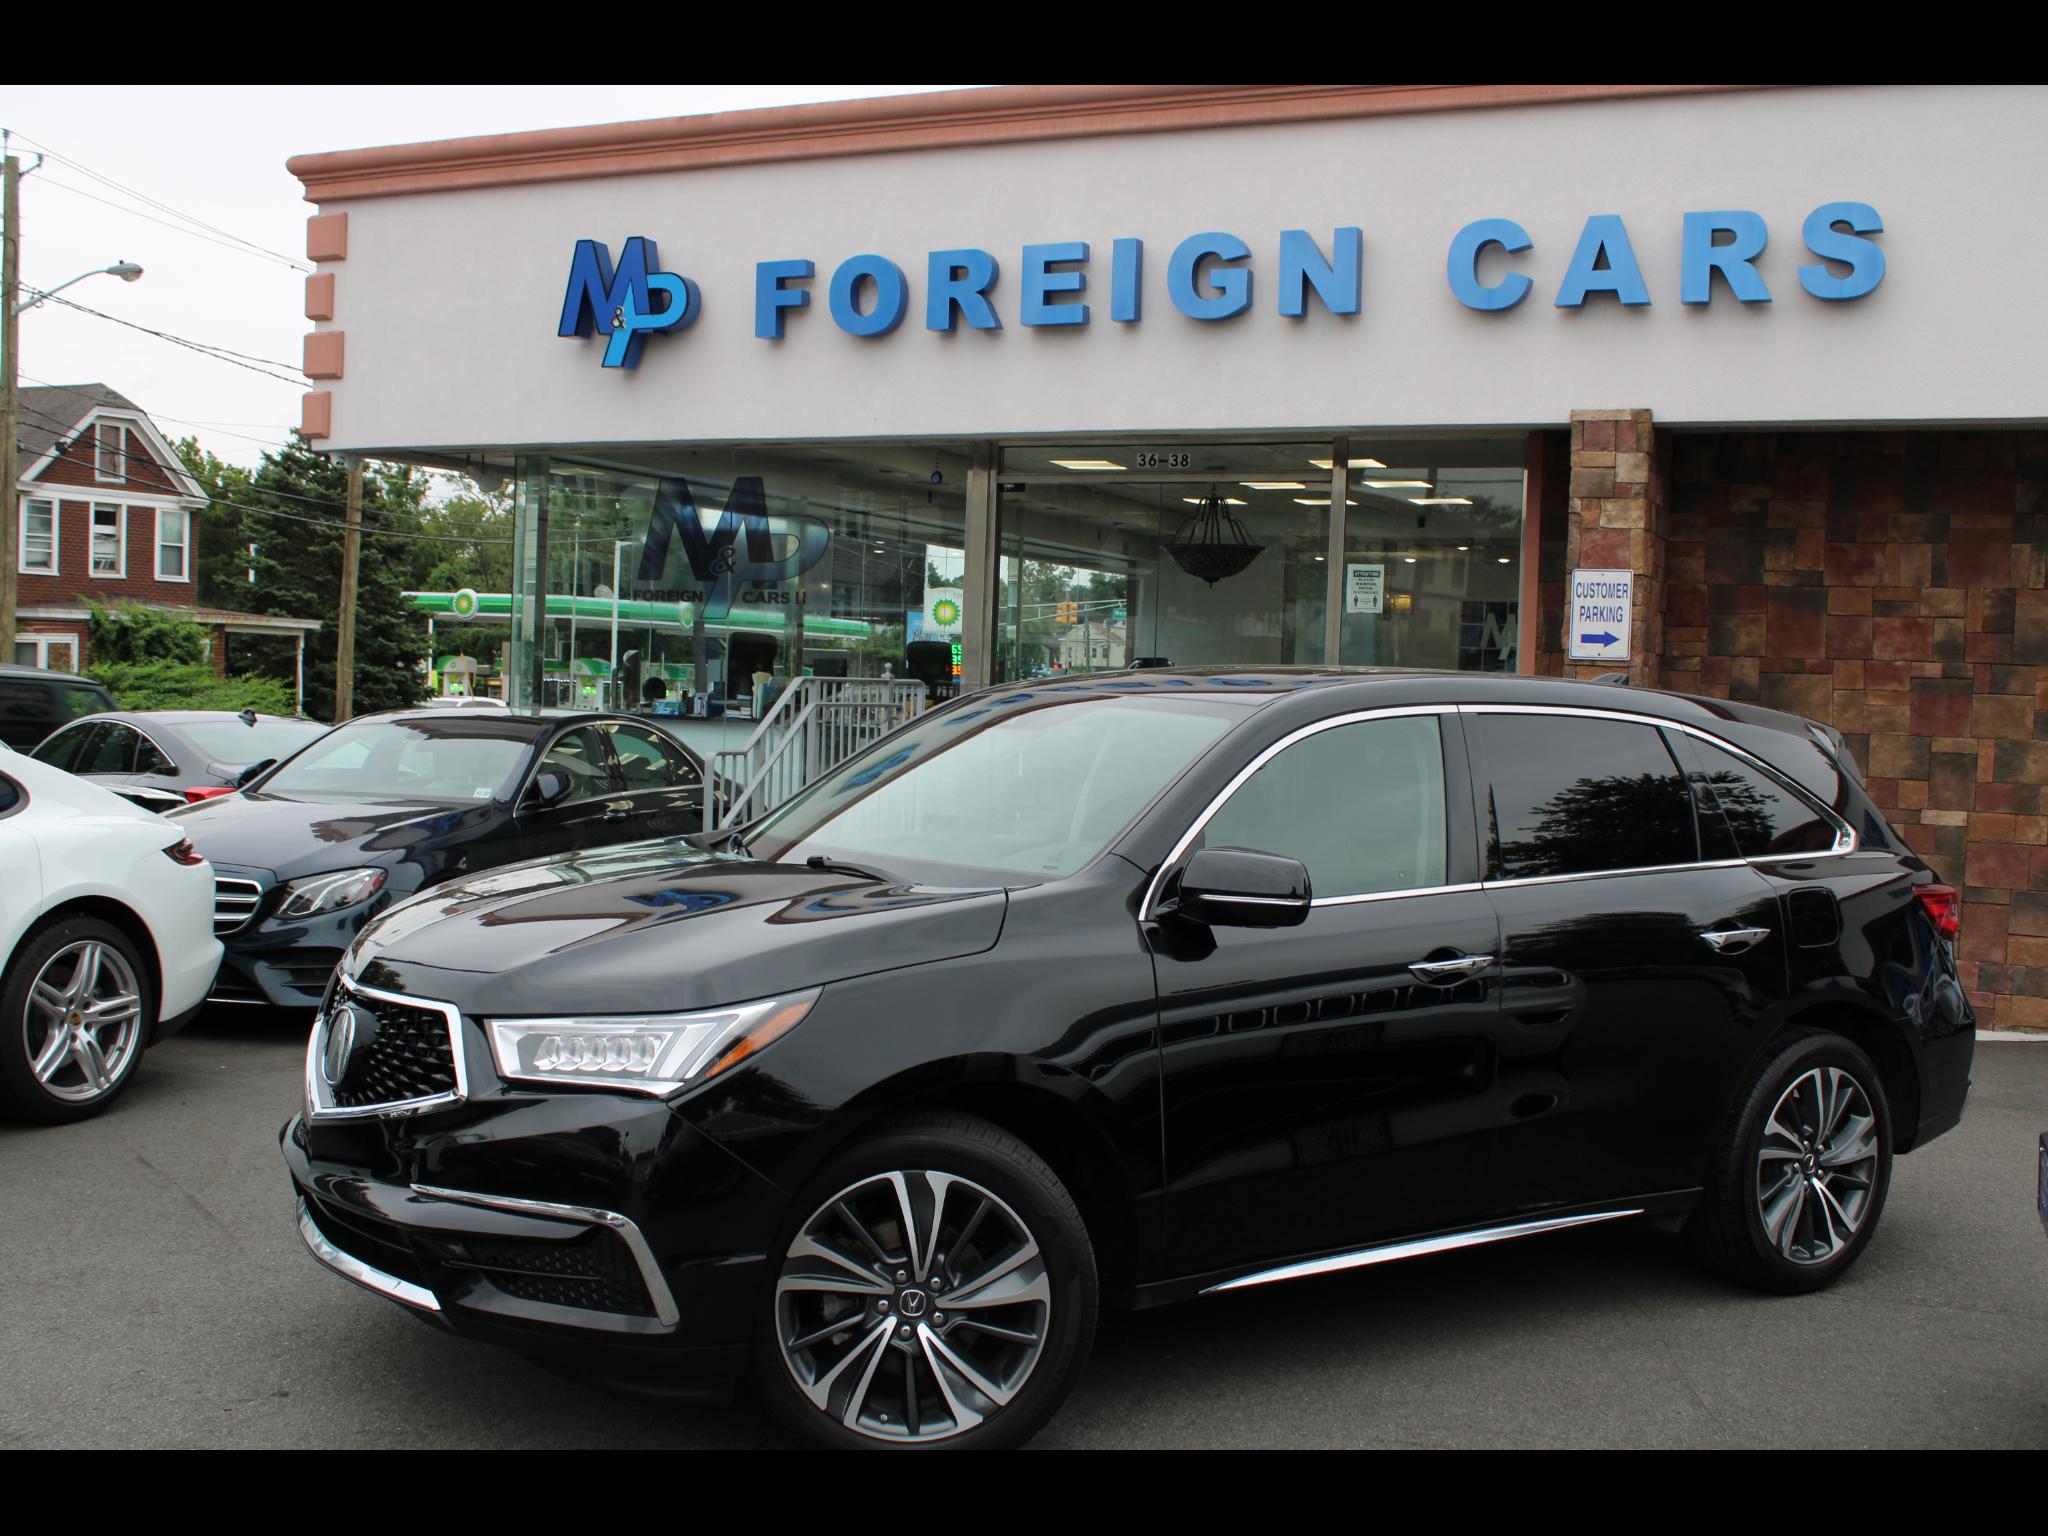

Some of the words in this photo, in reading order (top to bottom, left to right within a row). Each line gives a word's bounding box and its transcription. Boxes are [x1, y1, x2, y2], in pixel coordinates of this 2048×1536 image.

[755, 226, 1363, 339] FOREIGN
[1447, 201, 1885, 311] CARS
[1138, 453, 1189, 468] 36-38
[633, 589, 704, 603] FOREIGN
[742, 591, 790, 604] CARS
[1576, 582, 1629, 599] CUSTOMER
[1579, 605, 1623, 623] PARKING
